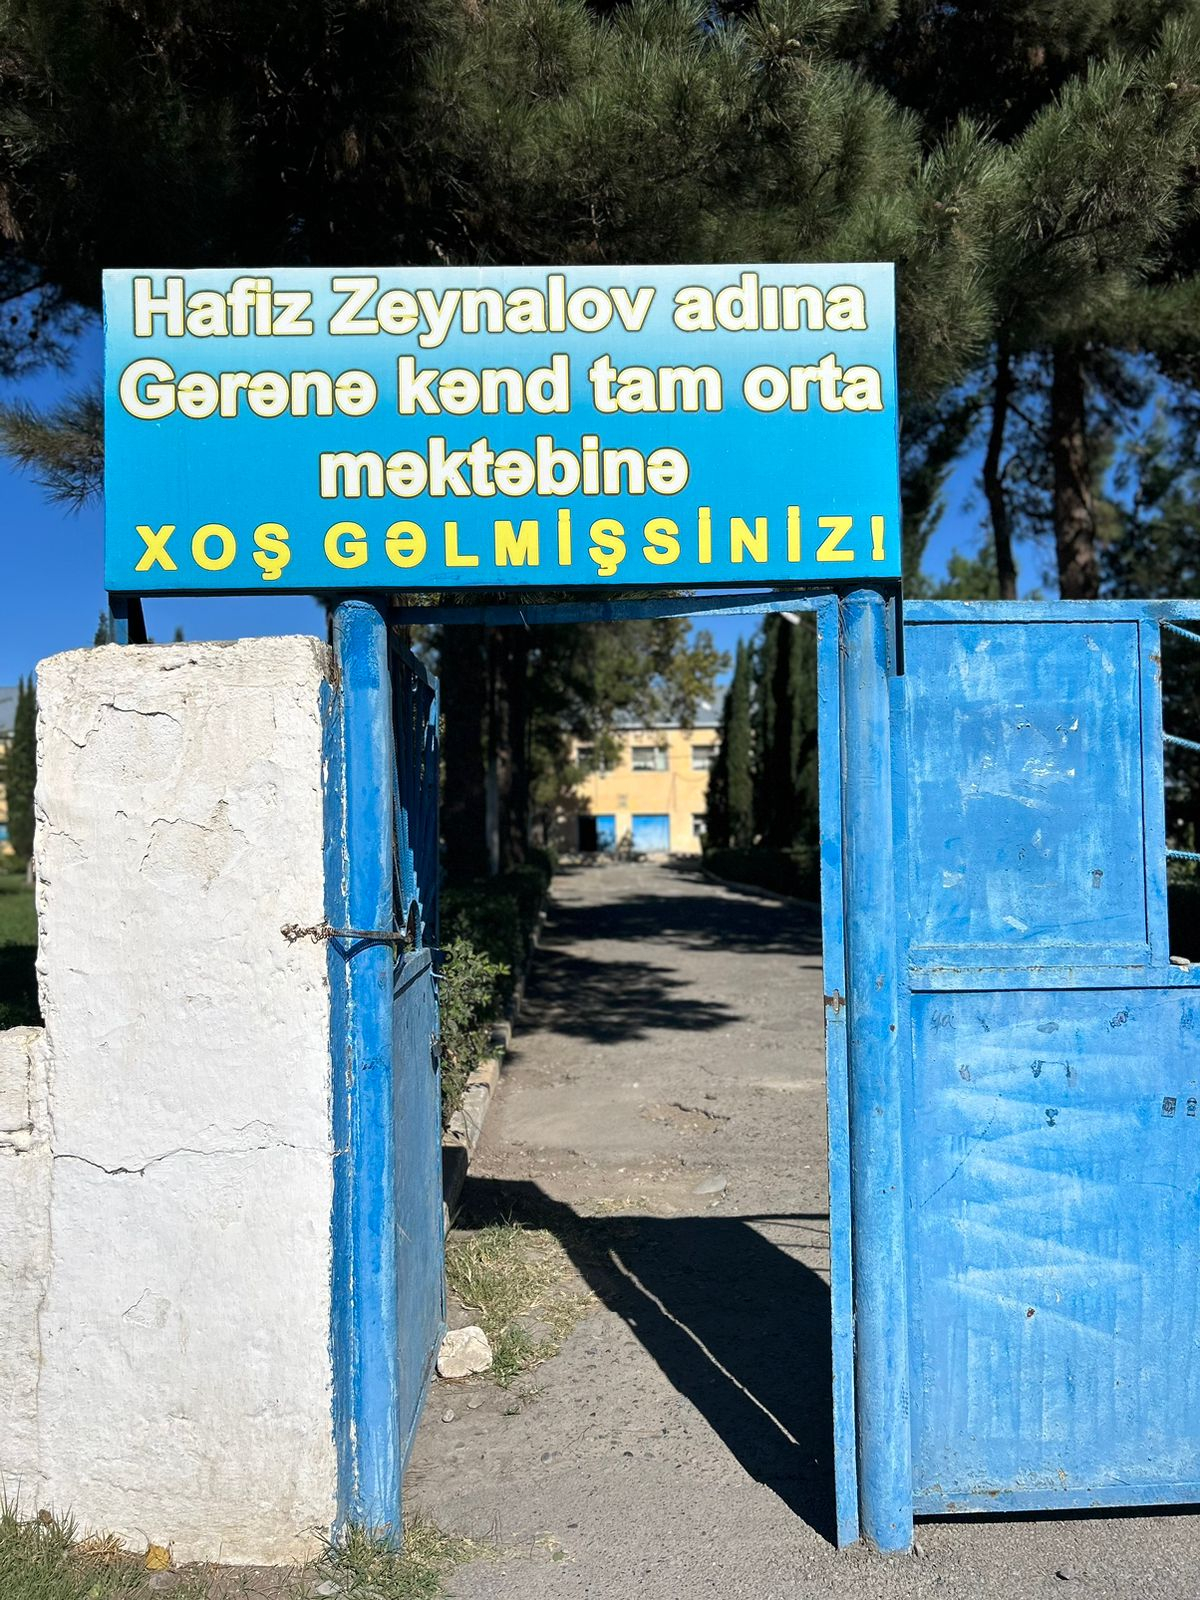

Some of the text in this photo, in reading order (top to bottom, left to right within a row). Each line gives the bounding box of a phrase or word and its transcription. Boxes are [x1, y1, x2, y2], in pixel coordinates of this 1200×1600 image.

[133, 271, 868, 349] Hafiz Zeynalov adına
[119, 352, 884, 421] Gərənə kənd tam orta
[319, 435, 690, 498] məktəbinə
[134, 505, 885, 581] XOŞ GƏLMİŞSİNİZ!
